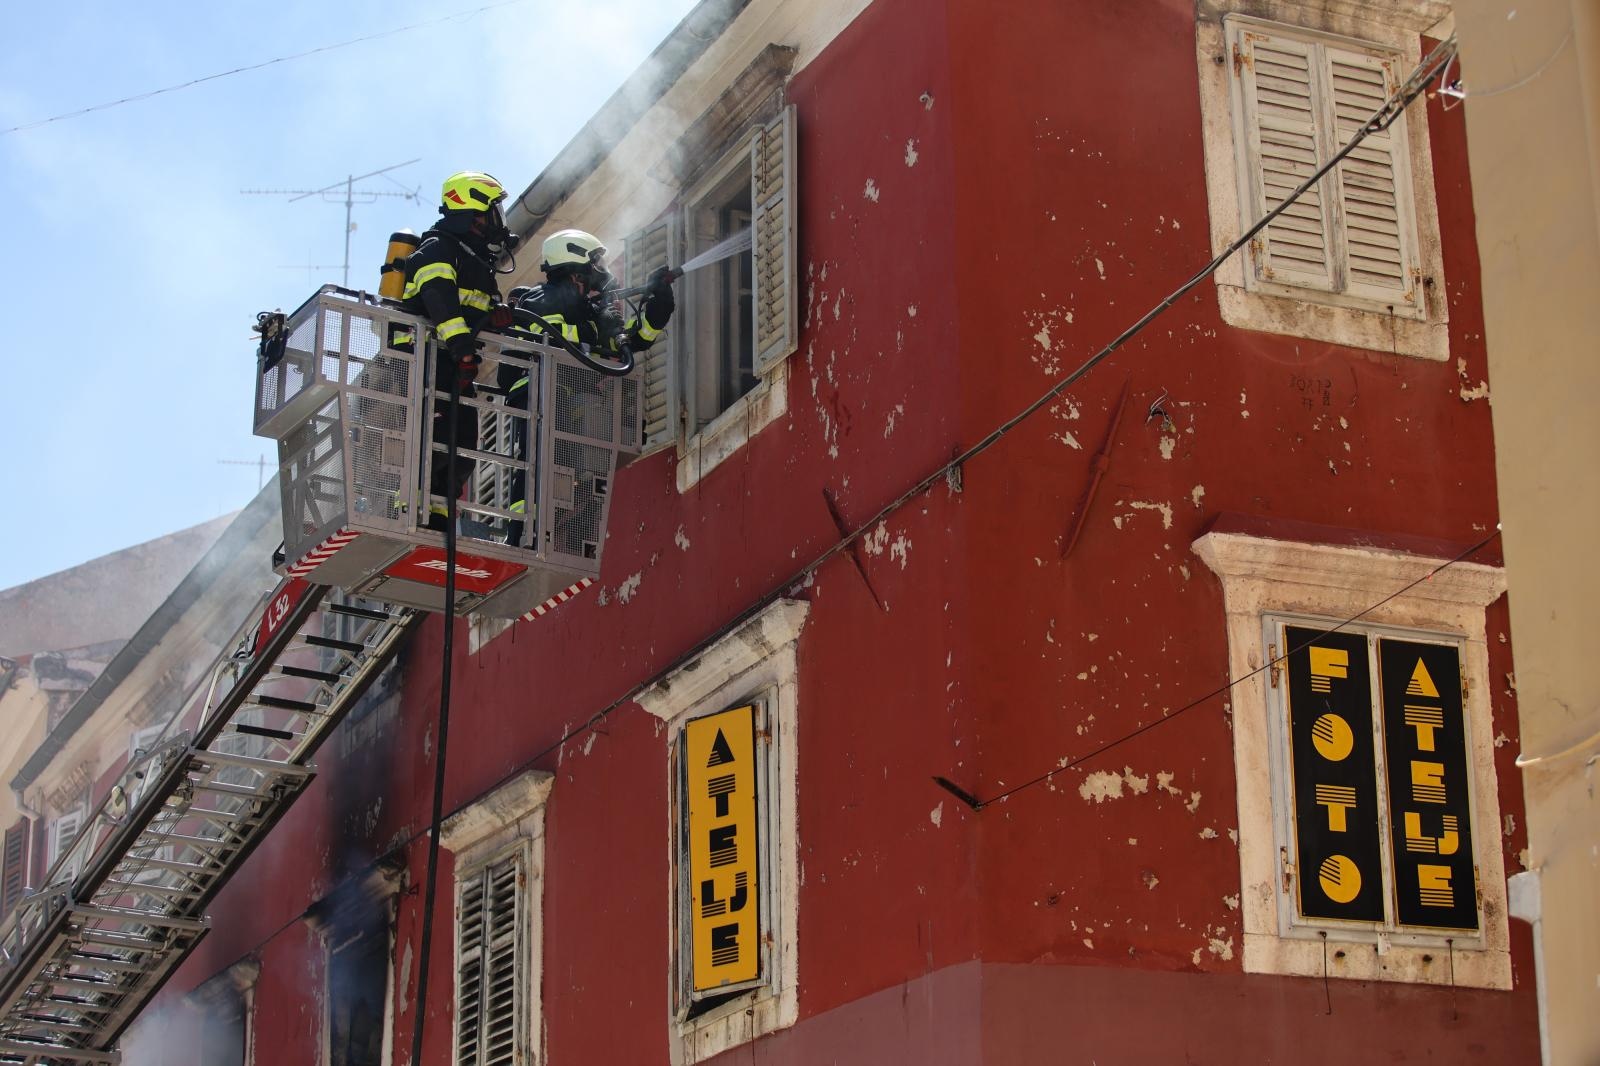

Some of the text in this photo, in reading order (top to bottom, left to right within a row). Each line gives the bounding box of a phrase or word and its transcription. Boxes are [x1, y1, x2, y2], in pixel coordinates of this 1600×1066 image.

[701, 727, 748, 968] ATELJE
[1309, 646, 1362, 904] FOTO
[1404, 656, 1459, 908] ATELJE
